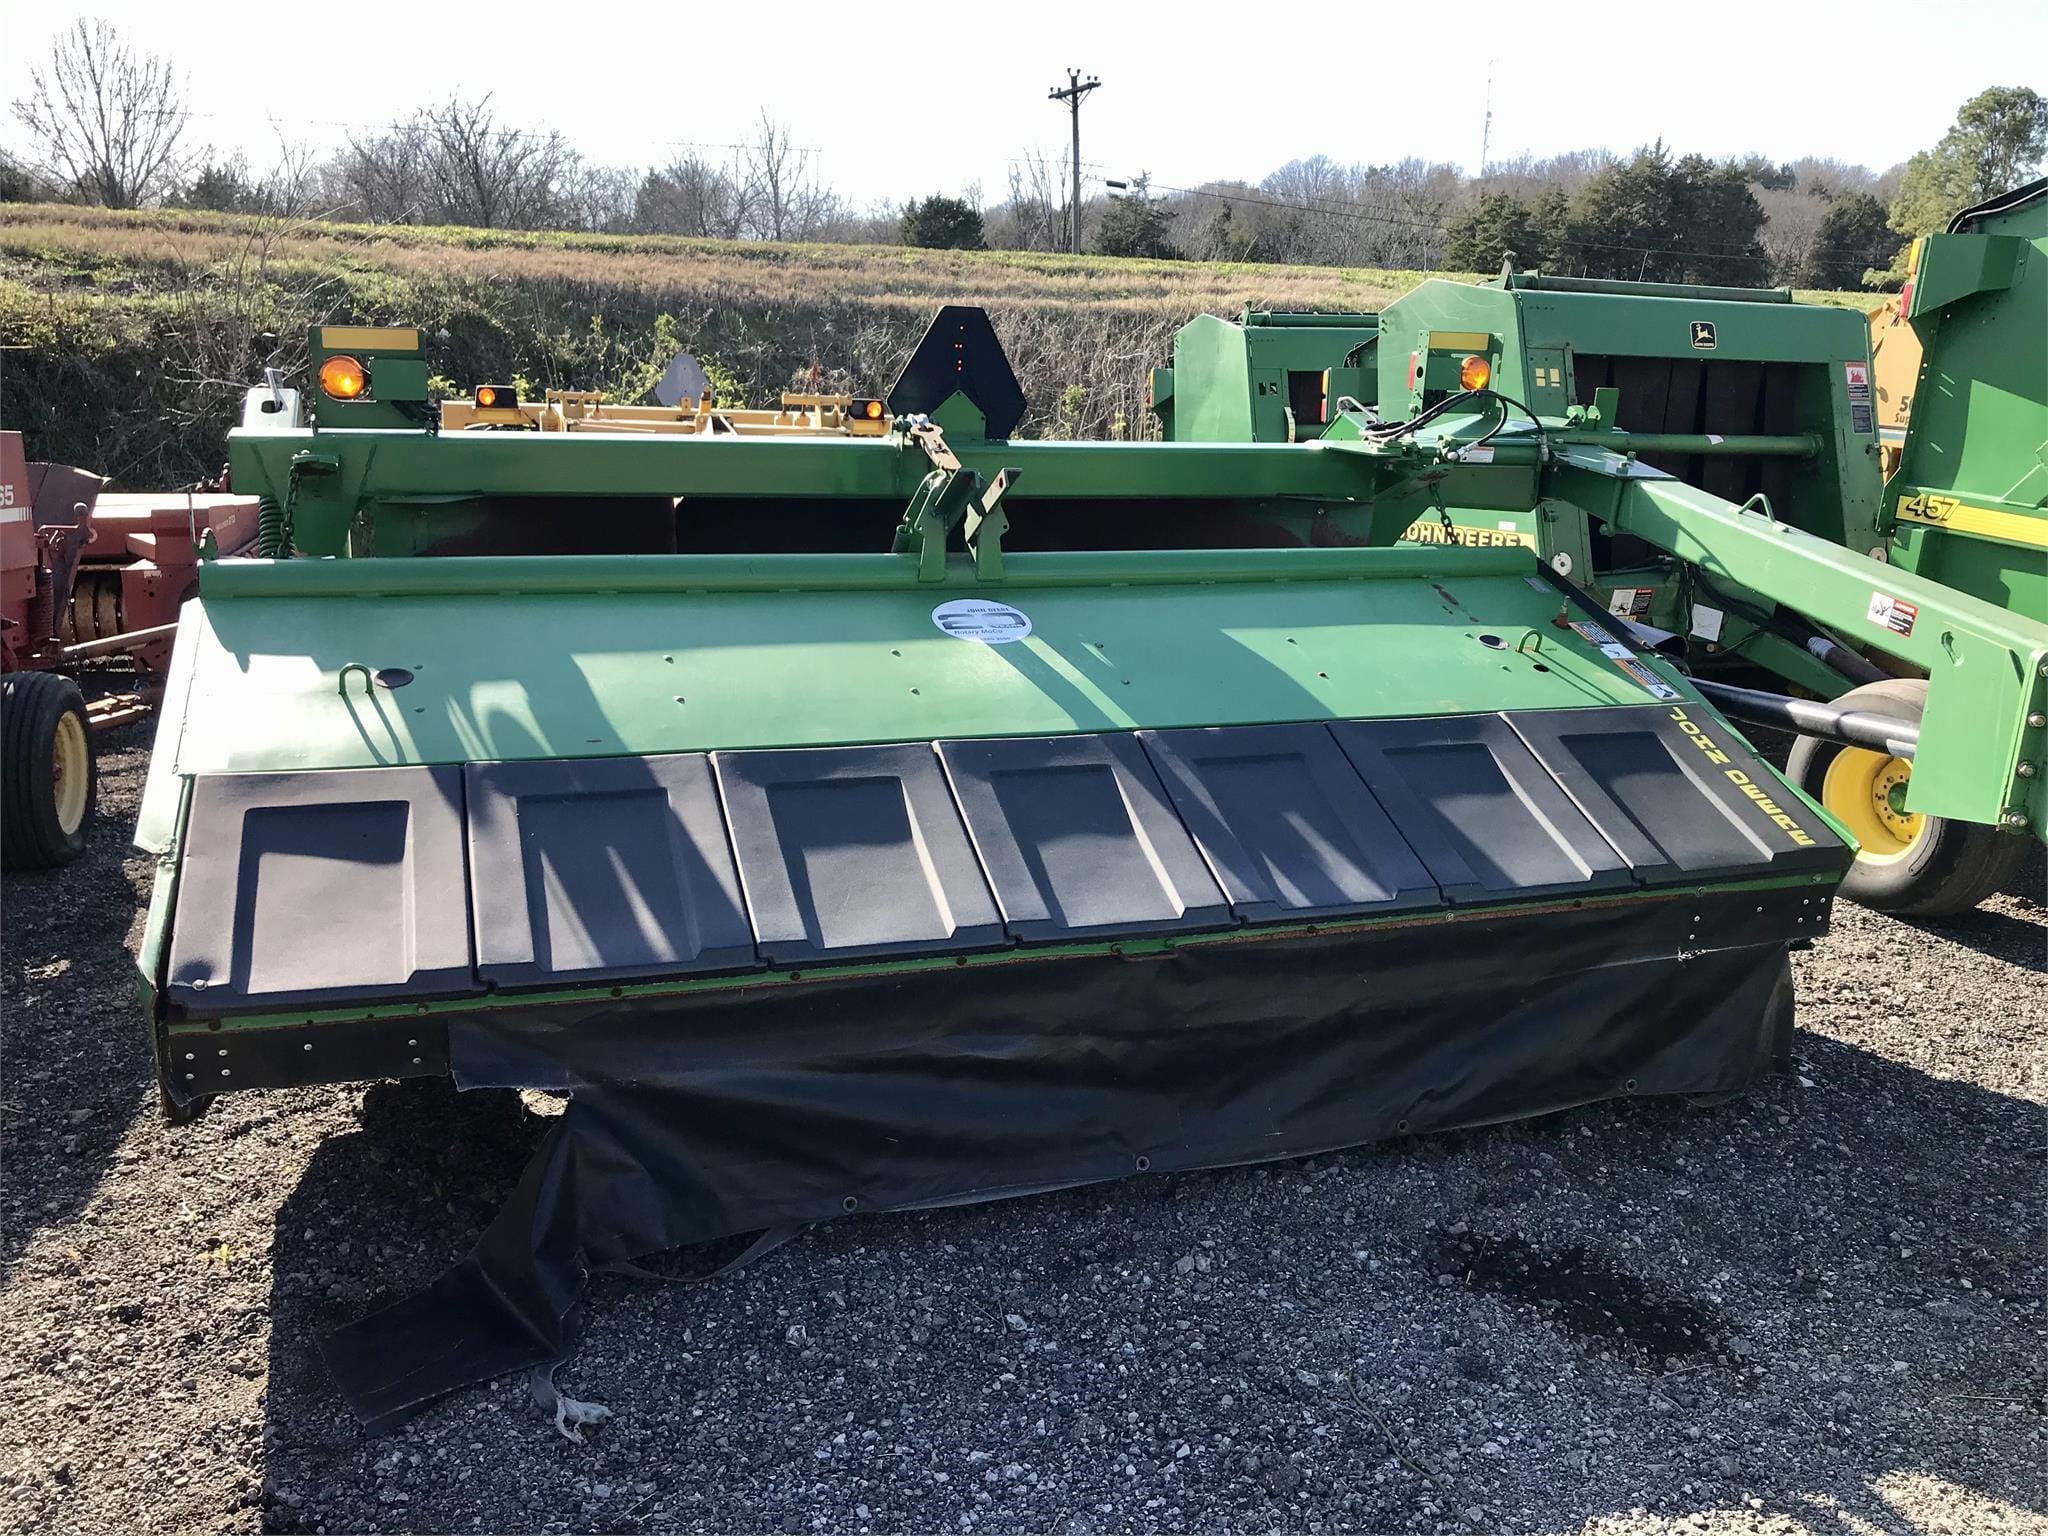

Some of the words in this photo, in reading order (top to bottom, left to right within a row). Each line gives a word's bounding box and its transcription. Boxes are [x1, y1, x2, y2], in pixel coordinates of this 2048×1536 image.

[1906, 493, 1961, 521] 457
[1669, 706, 1732, 765] JOHN
[1723, 769, 1817, 846] DEERE
